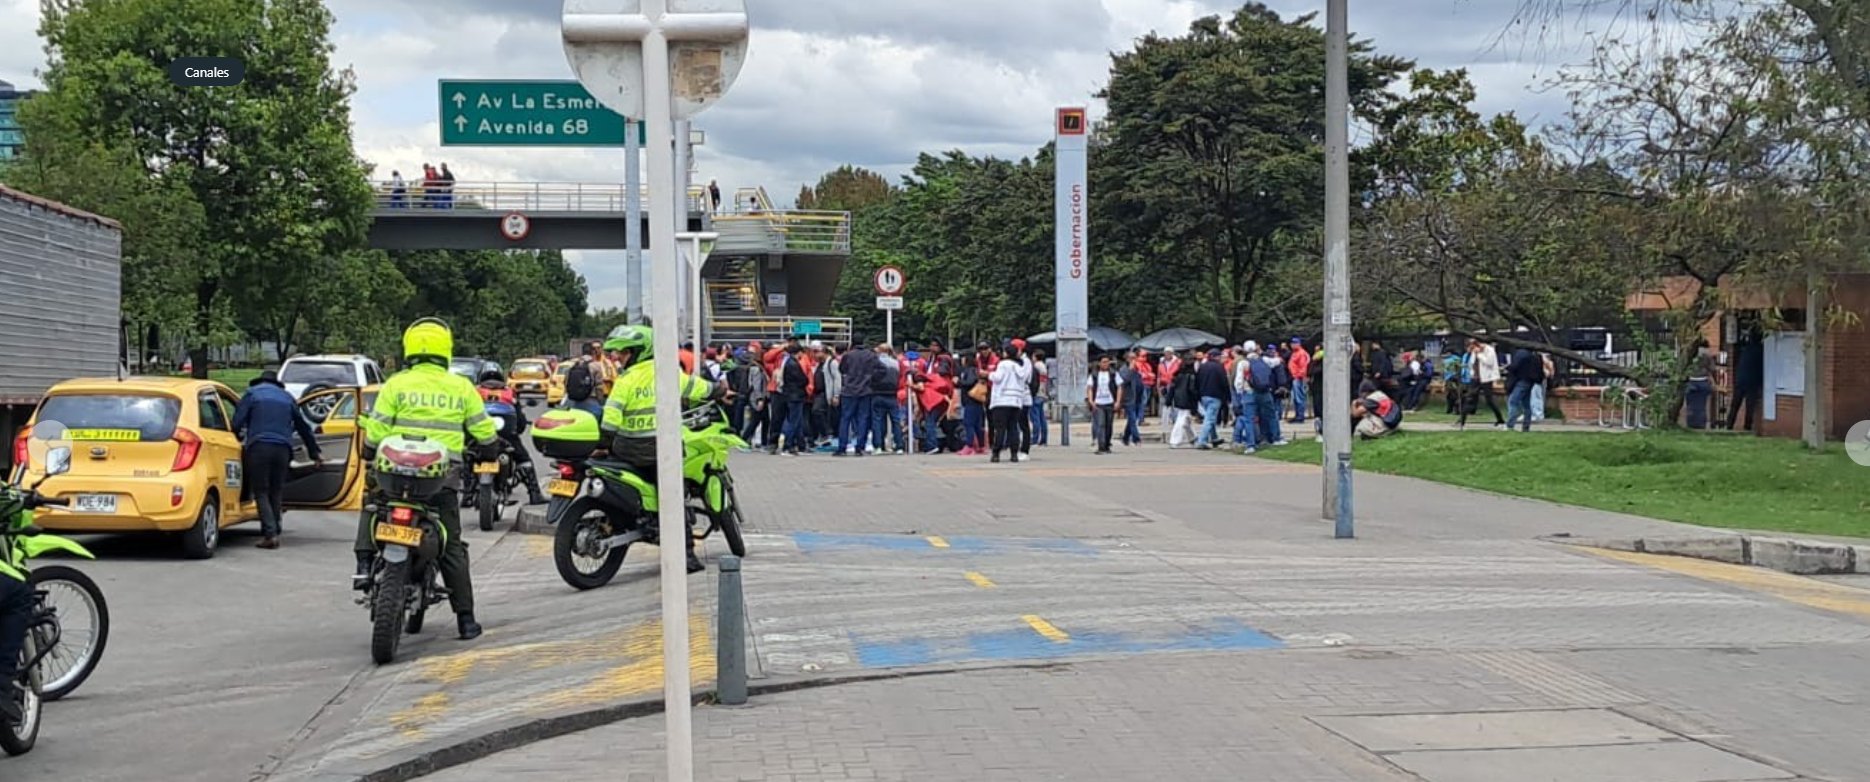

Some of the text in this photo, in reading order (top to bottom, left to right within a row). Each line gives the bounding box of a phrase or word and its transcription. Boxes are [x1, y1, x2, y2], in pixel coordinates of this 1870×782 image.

[477, 93, 605, 110] Av La Esmer
[478, 119, 588, 135] Avenida 68
[397, 391, 466, 411] POLICIA
[627, 416, 655, 429] 904
